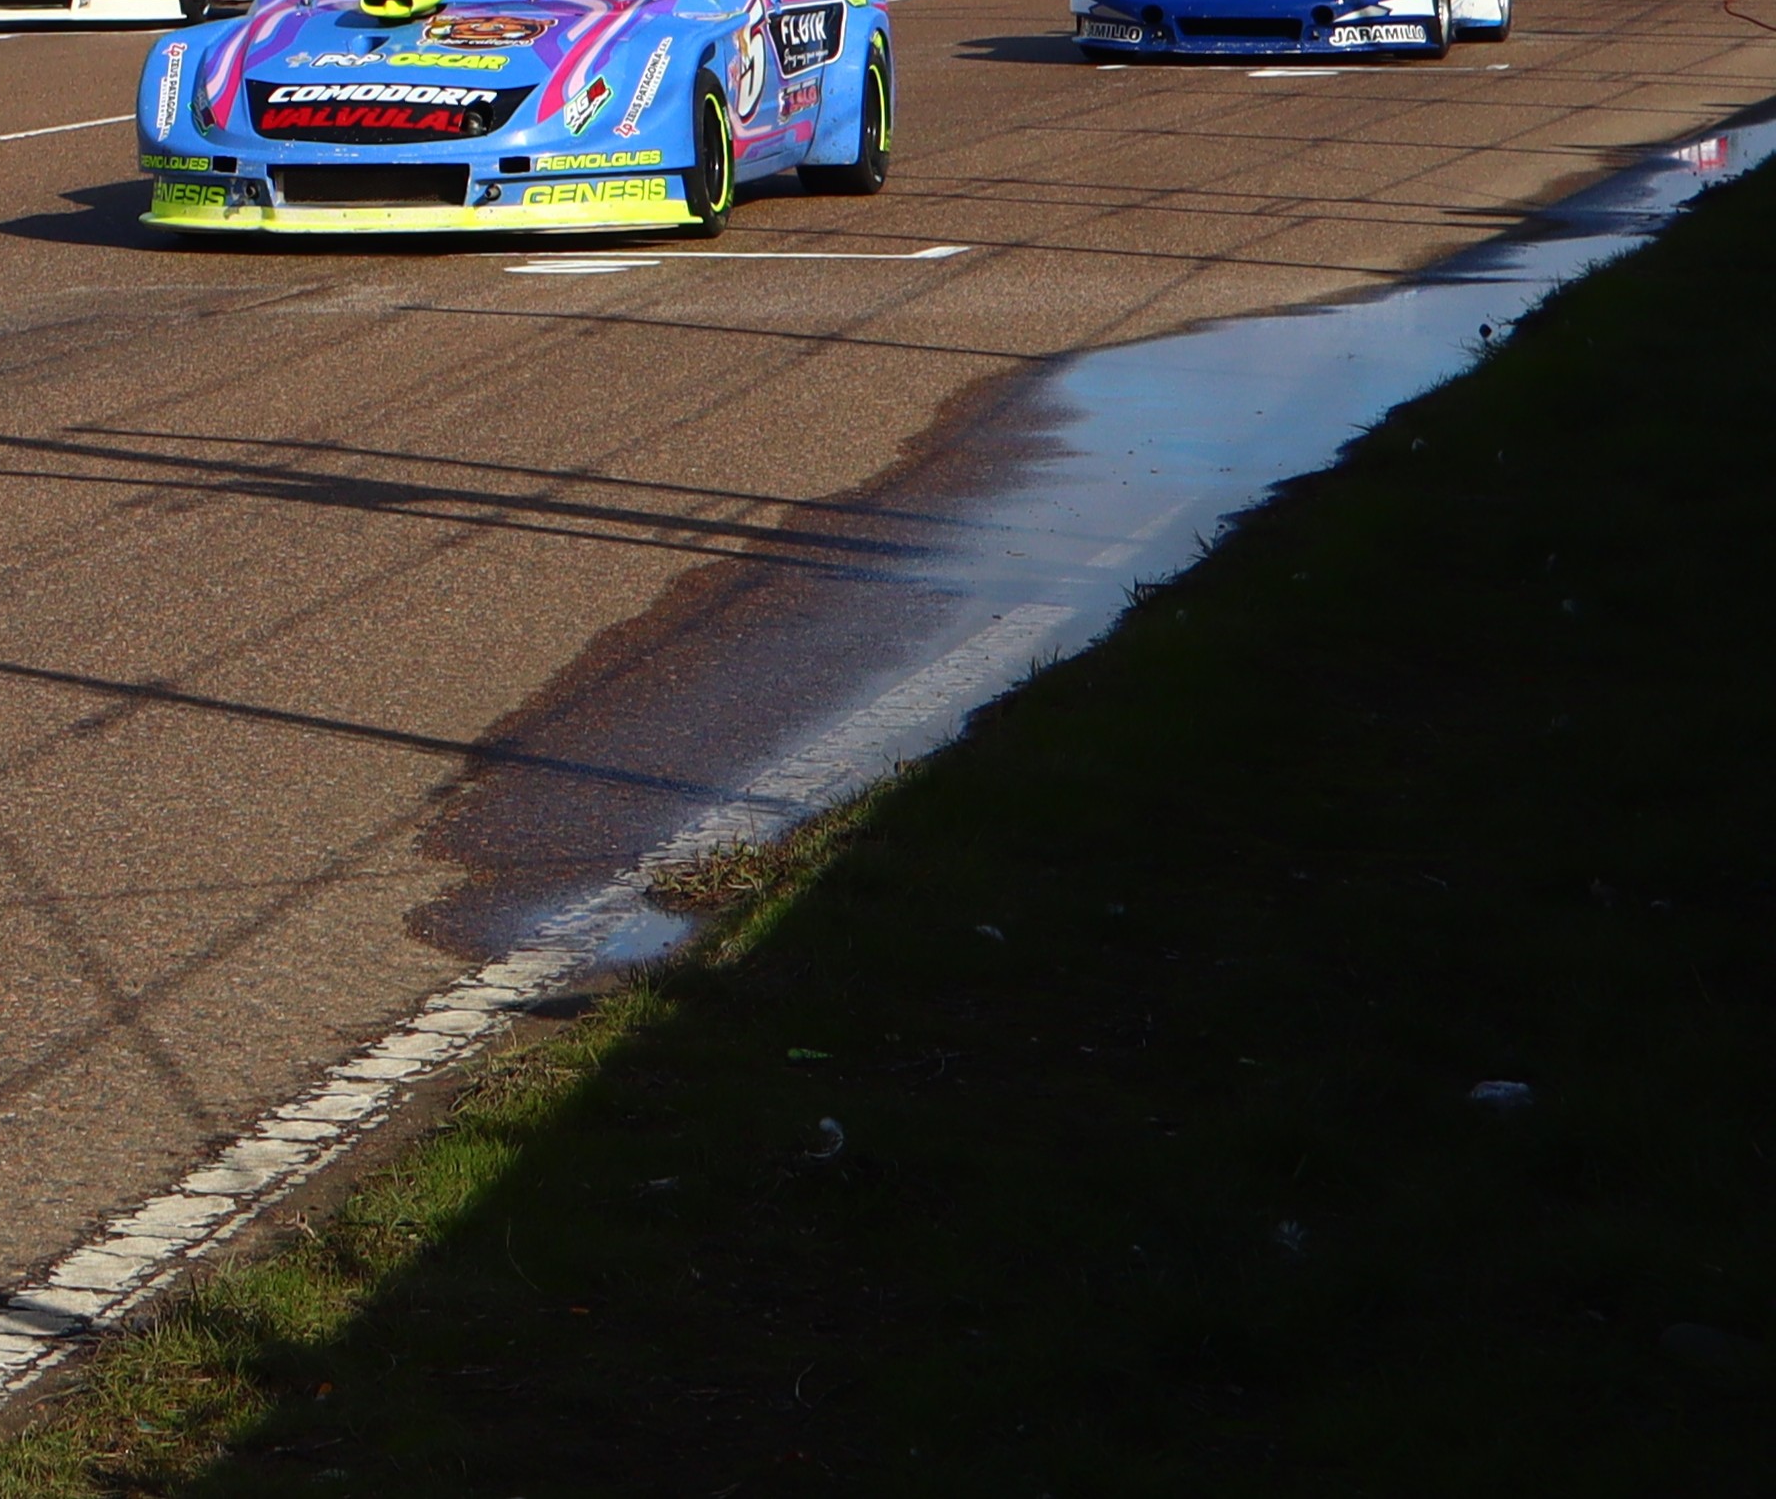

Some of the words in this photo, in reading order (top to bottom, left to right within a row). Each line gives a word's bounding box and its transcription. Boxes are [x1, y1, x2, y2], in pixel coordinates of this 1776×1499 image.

[1329, 25, 1427, 45] JARAMILLO
[389, 53, 508, 69] OSCAR
[625, 103, 642, 124] ZEUS
[636, 53, 663, 103] PATAGONIA
[536, 151, 661, 171] REMOLQUES
[523, 178, 666, 206] GENESIS
